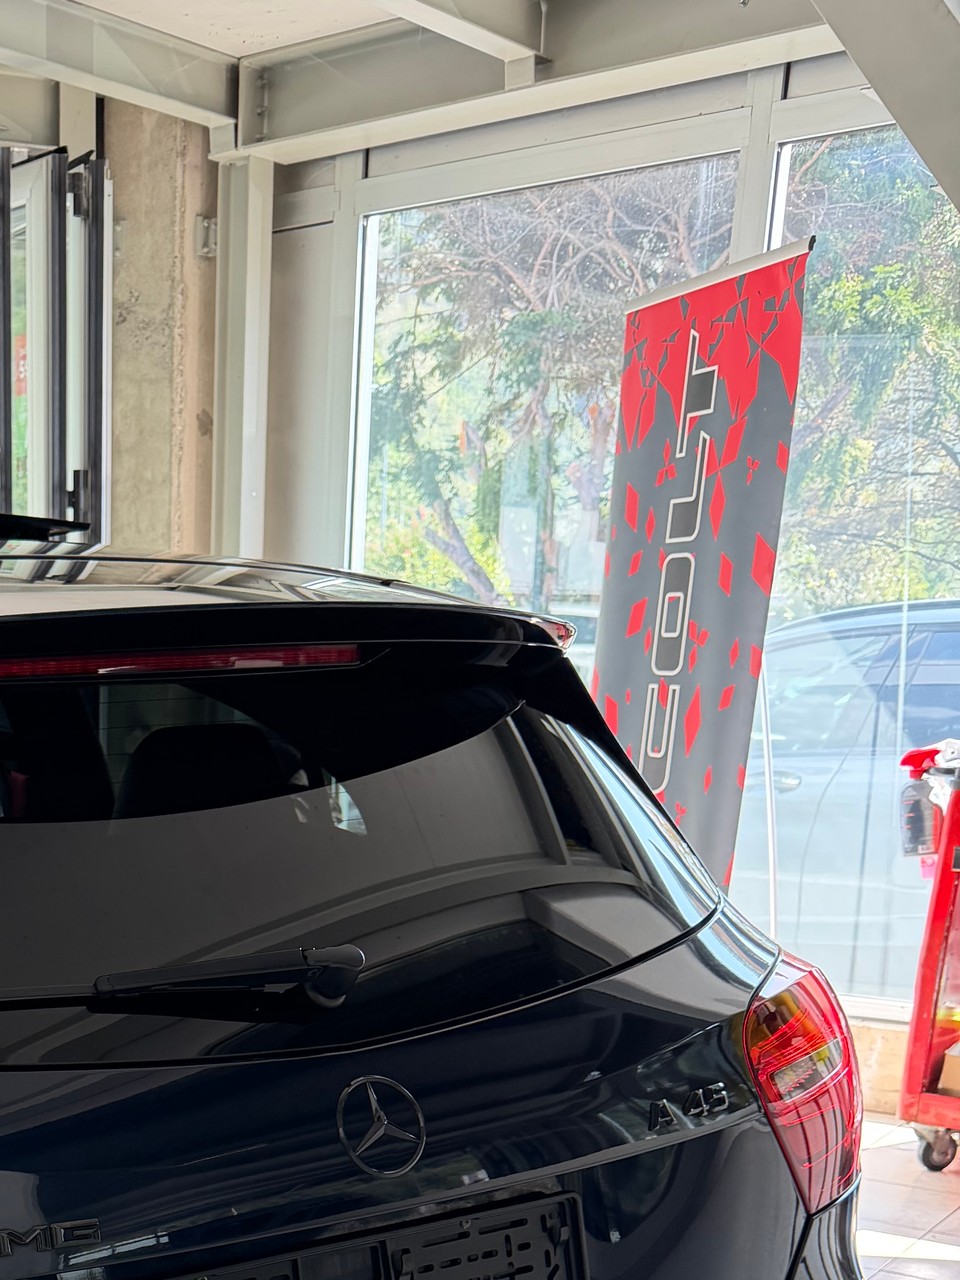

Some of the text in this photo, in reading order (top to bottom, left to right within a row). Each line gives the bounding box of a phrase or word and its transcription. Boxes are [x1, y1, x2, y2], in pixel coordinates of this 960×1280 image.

[639, 328, 719, 795] COLT
[648, 1081, 729, 1131] A 45
